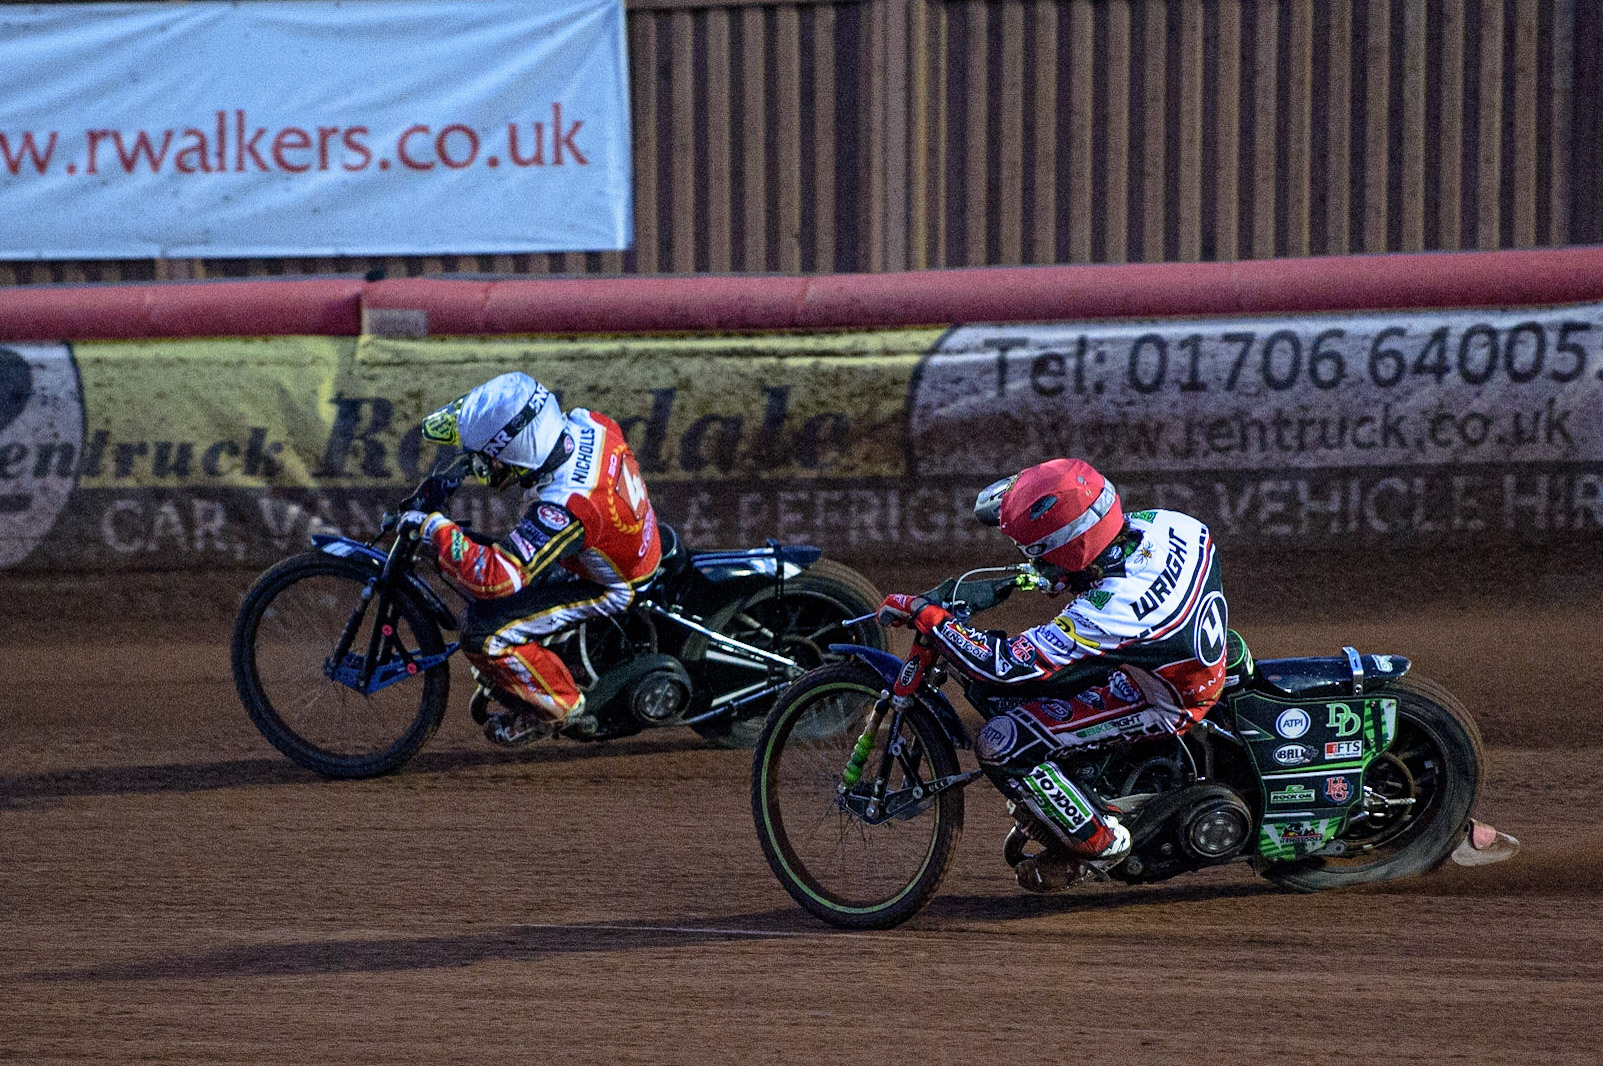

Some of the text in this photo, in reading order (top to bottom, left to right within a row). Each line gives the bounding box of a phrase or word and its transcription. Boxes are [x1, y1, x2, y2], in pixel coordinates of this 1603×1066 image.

[982, 320, 1603, 397] Tel: 01706 64005
[571, 427, 596, 484] NICHOLLS
[1129, 526, 1188, 622] WRIGHT
[1201, 600, 1225, 649] 4
[1282, 718, 1304, 728] ATPI
[1337, 741, 1361, 753] FTS
[1050, 789, 1087, 826] ROCK
